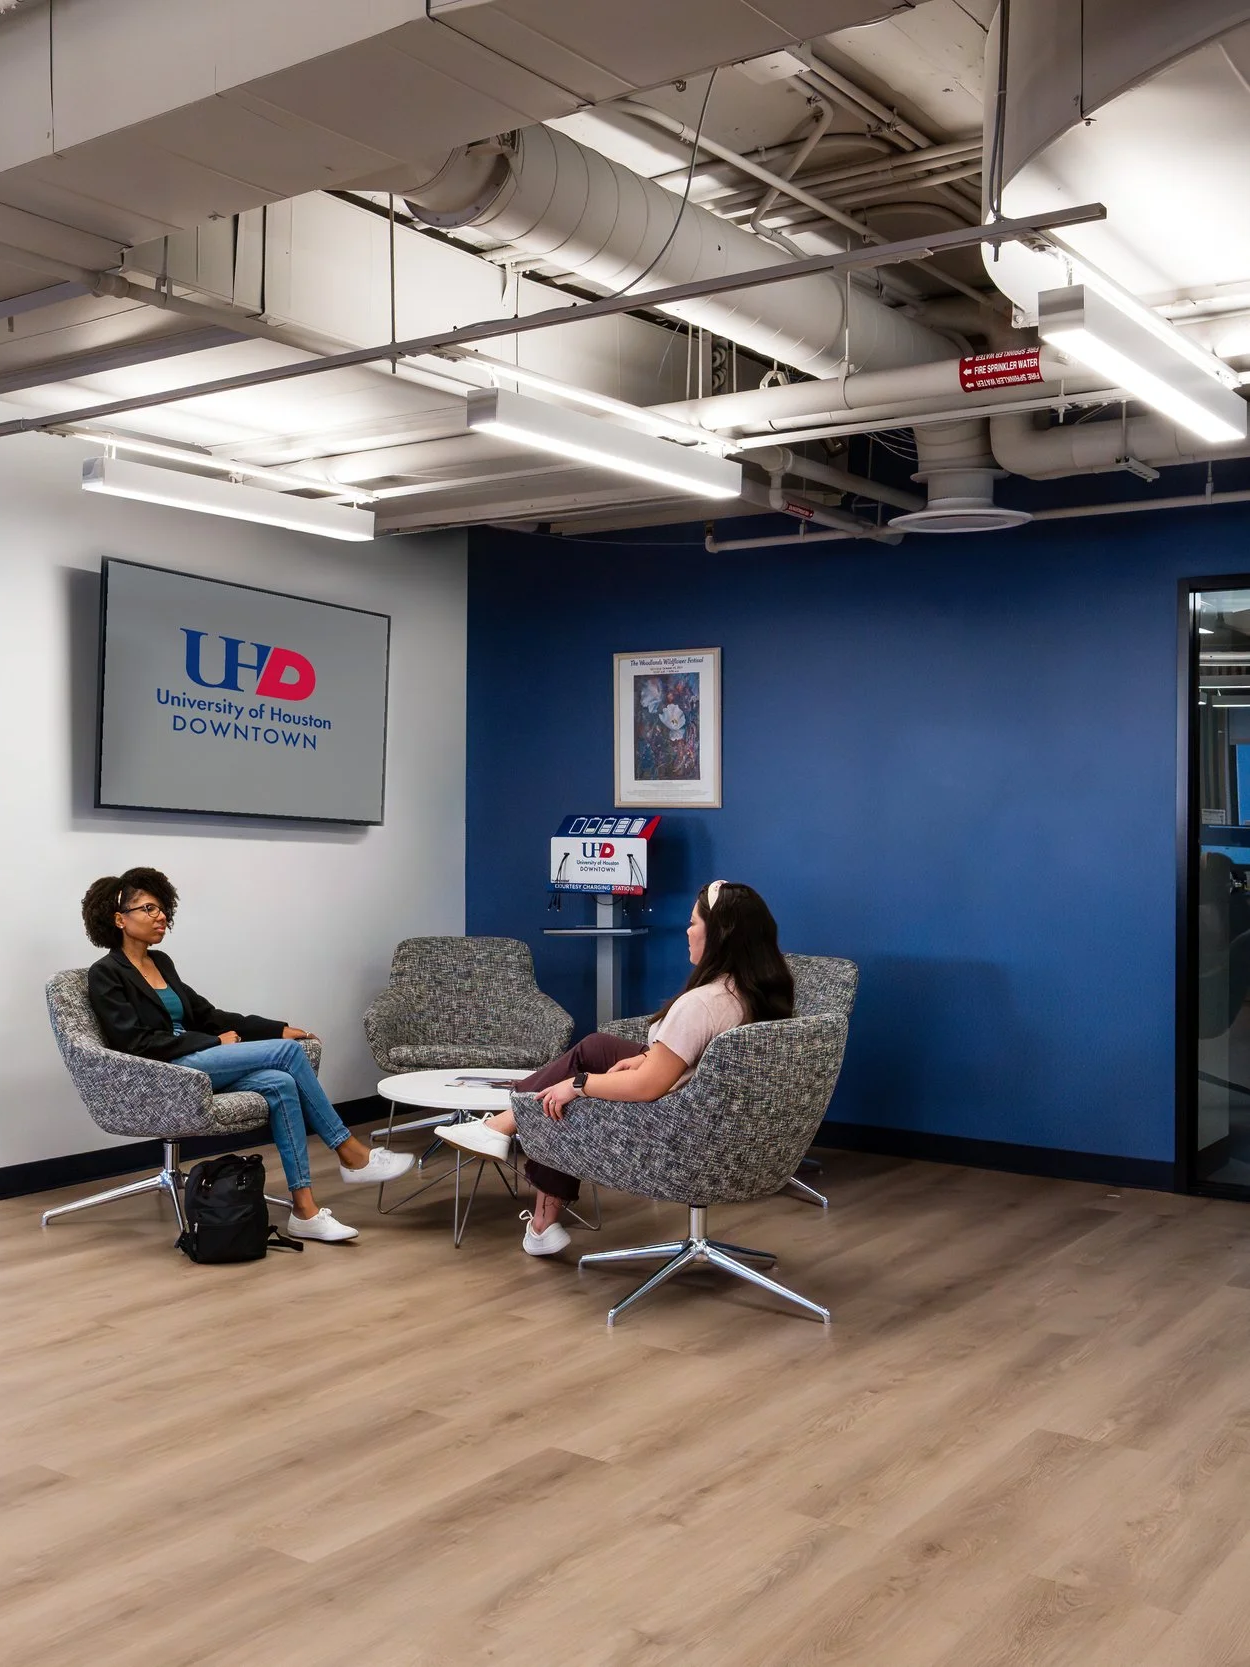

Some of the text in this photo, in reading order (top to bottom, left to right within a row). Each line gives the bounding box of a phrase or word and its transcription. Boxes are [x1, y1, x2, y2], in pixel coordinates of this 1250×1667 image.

[974, 358, 1038, 376] FIRE SPRINKLER WATER
[976, 372, 1041, 388] FIRE SPRINKLER WATER
[179, 627, 316, 701] UHD
[156, 687, 332, 730] University of Houston
[172, 715, 317, 751] DOWNTOWN
[581, 842, 615, 858] UHD
